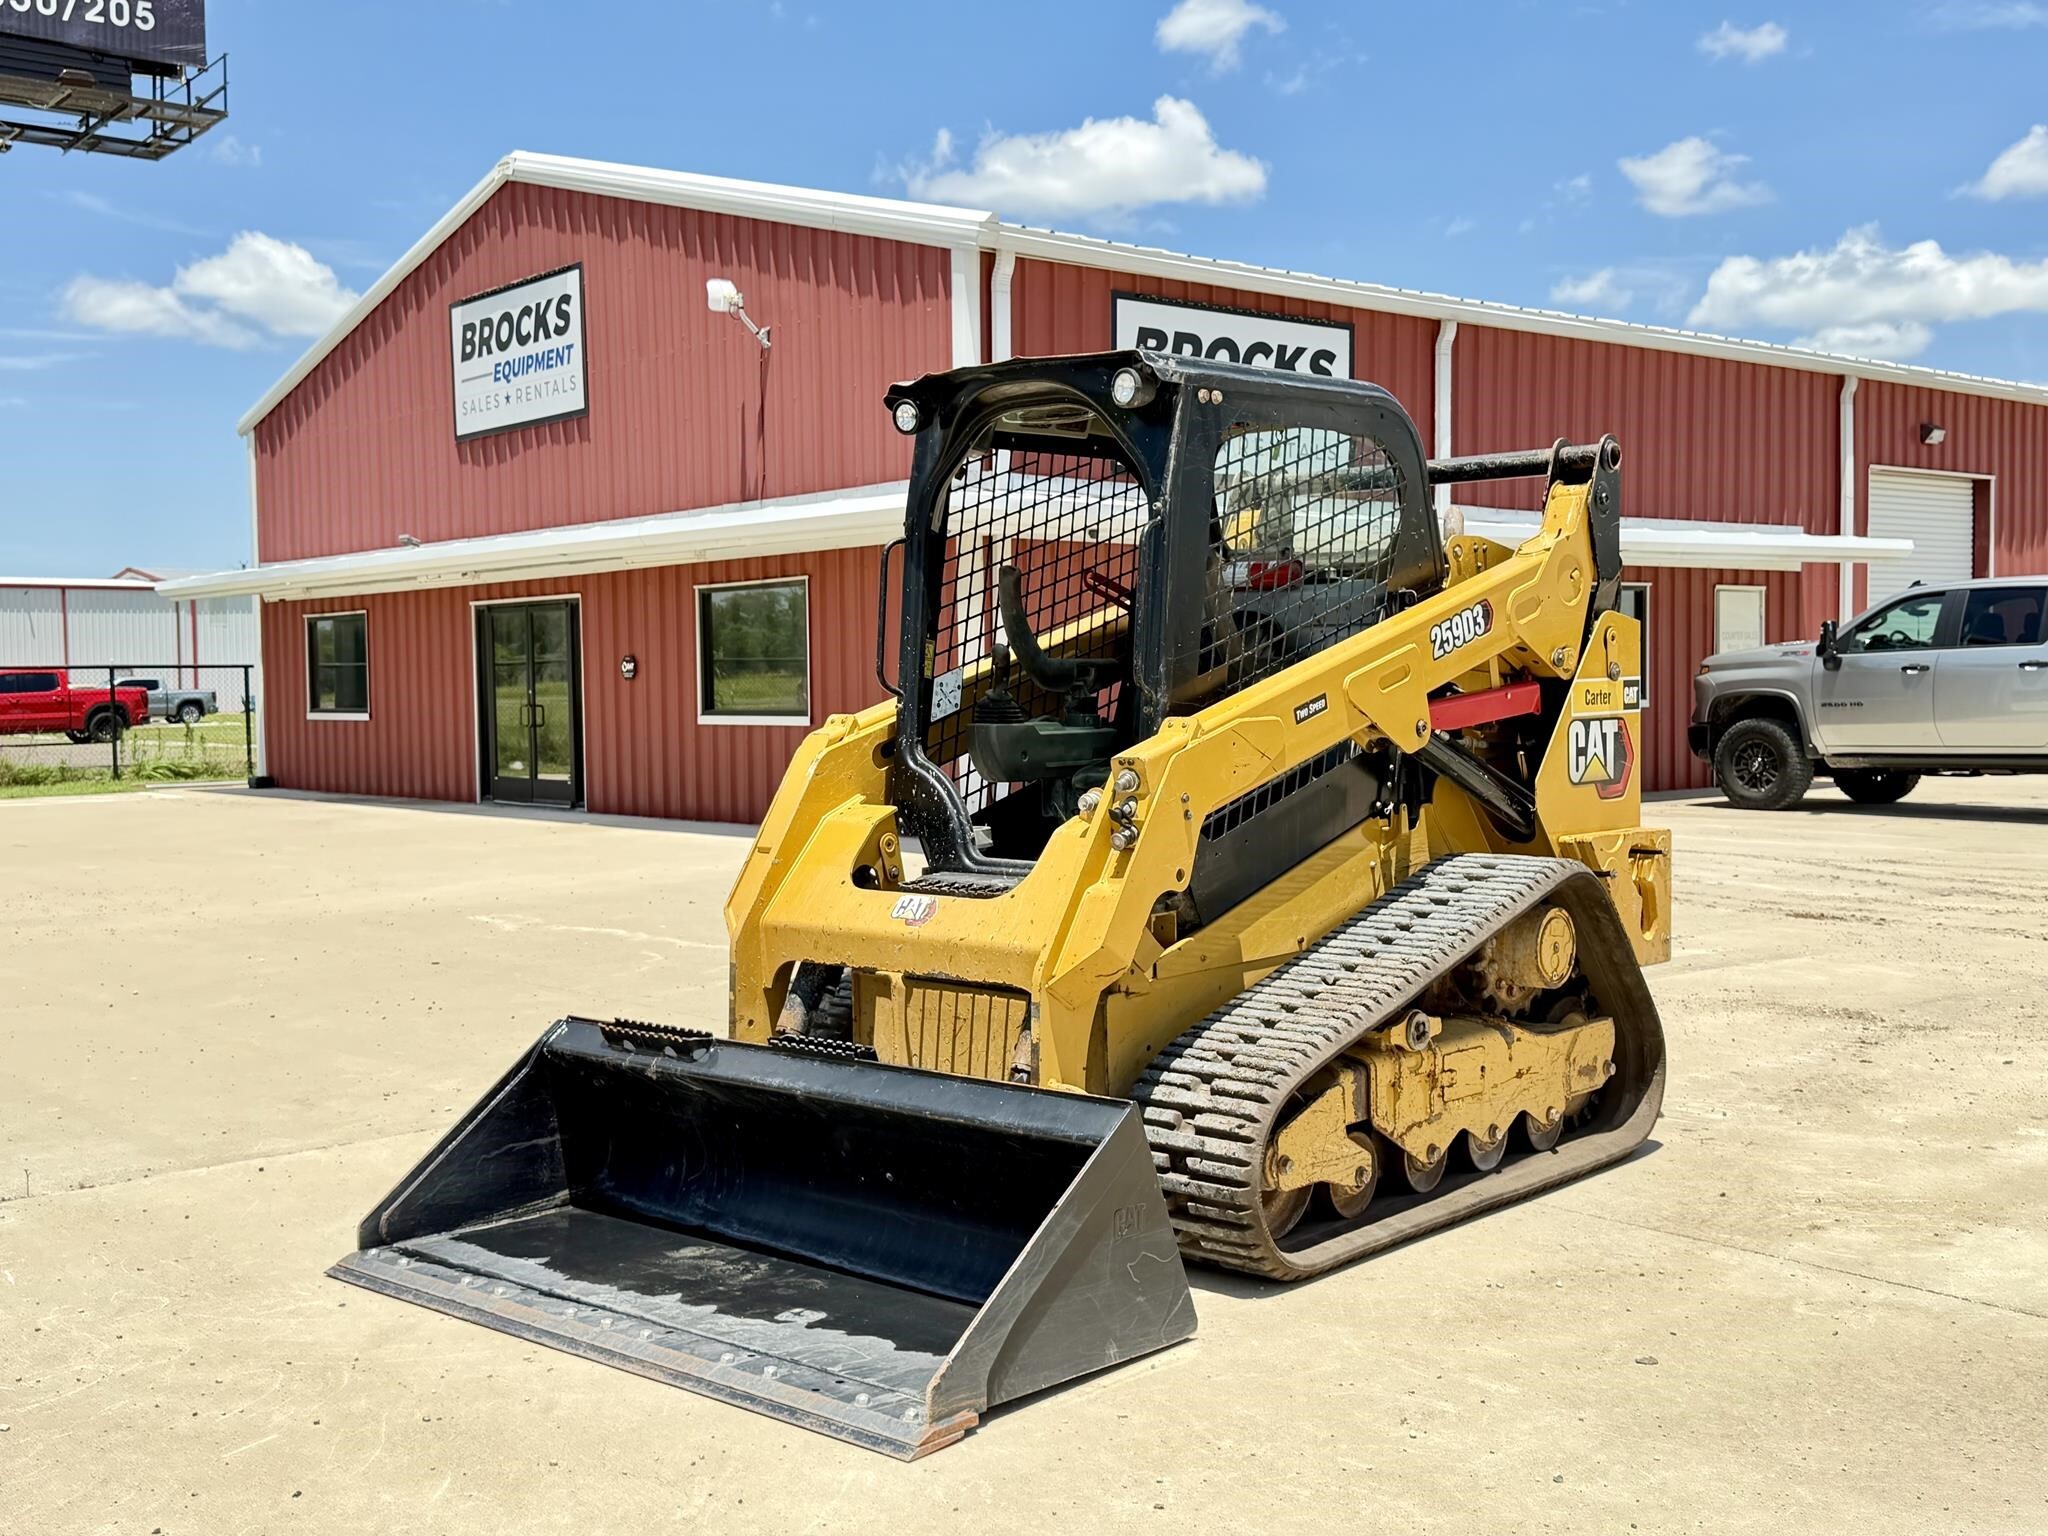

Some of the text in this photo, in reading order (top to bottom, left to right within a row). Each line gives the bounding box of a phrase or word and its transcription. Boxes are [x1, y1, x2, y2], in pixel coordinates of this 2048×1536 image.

[461, 293, 572, 362] BROCKS
[494, 343, 574, 384] EQUIPMENT
[462, 375, 577, 416] SALES RENTALS
[1238, 435, 1337, 461] RETALS
[1430, 603, 1486, 660] 259D3
[1585, 686, 1639, 706] Carter CAT
[1569, 719, 1619, 784] CAT
[891, 895, 934, 919] CAT
[1112, 1202, 1146, 1240] CAT
